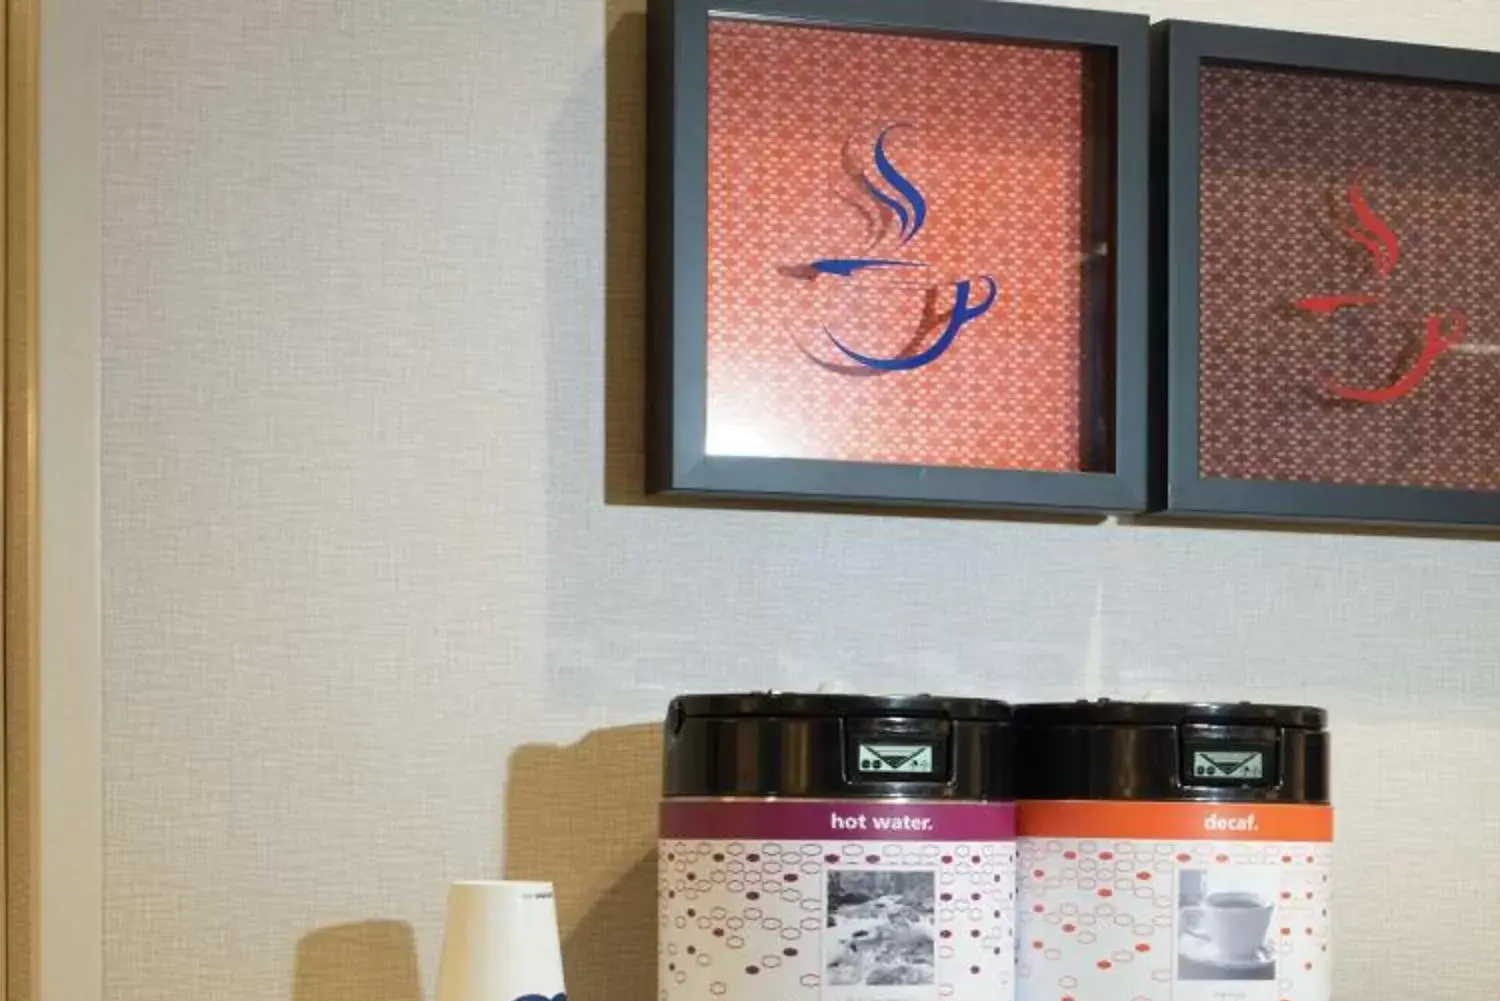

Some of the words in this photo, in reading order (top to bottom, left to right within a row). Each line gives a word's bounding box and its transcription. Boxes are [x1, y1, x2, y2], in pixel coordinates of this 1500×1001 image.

[831, 812, 867, 830] hot
[871, 814, 934, 831] water.
[1203, 813, 1259, 831] decaf.
